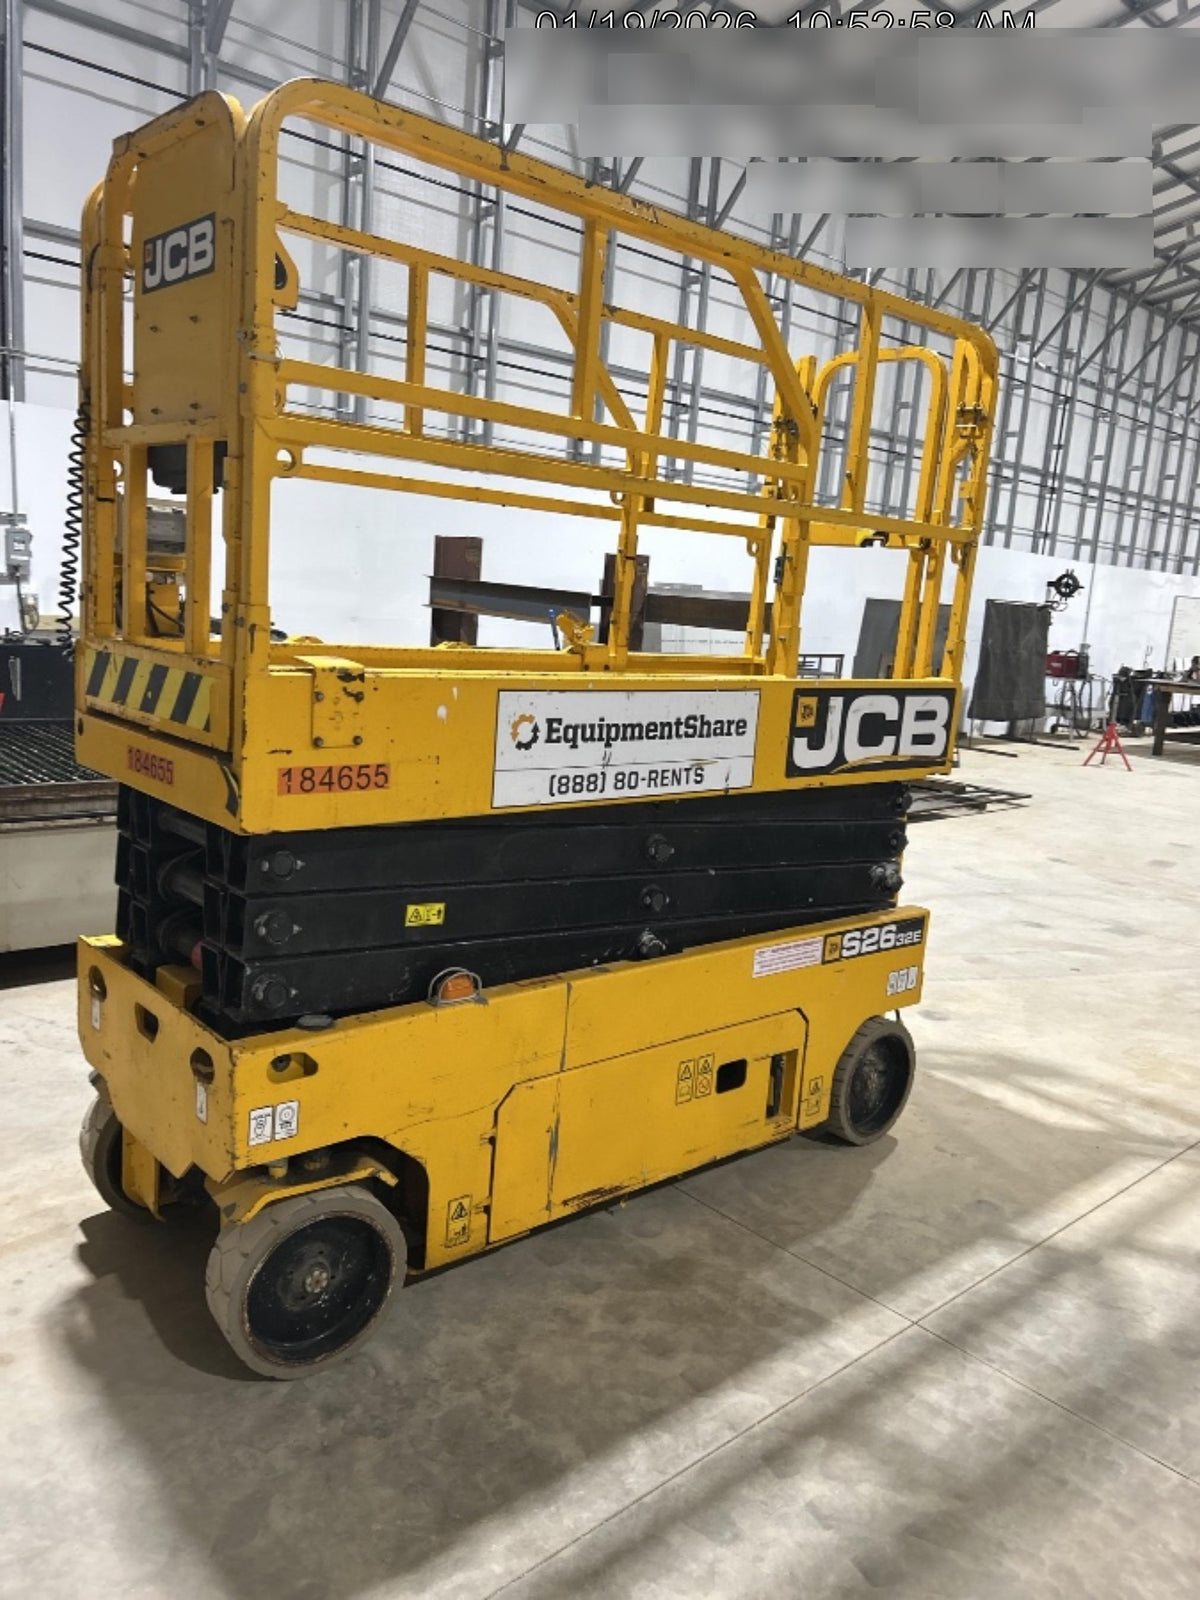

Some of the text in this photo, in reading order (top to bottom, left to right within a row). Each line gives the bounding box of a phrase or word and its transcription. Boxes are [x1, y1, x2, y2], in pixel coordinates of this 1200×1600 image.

[145, 219, 213, 288] JCB
[544, 714, 748, 749] EquipmentShare
[792, 694, 950, 769] JCB
[128, 746, 174, 785] 184655
[281, 763, 390, 794] 184655
[549, 767, 705, 797] (888) 80-RENTS
